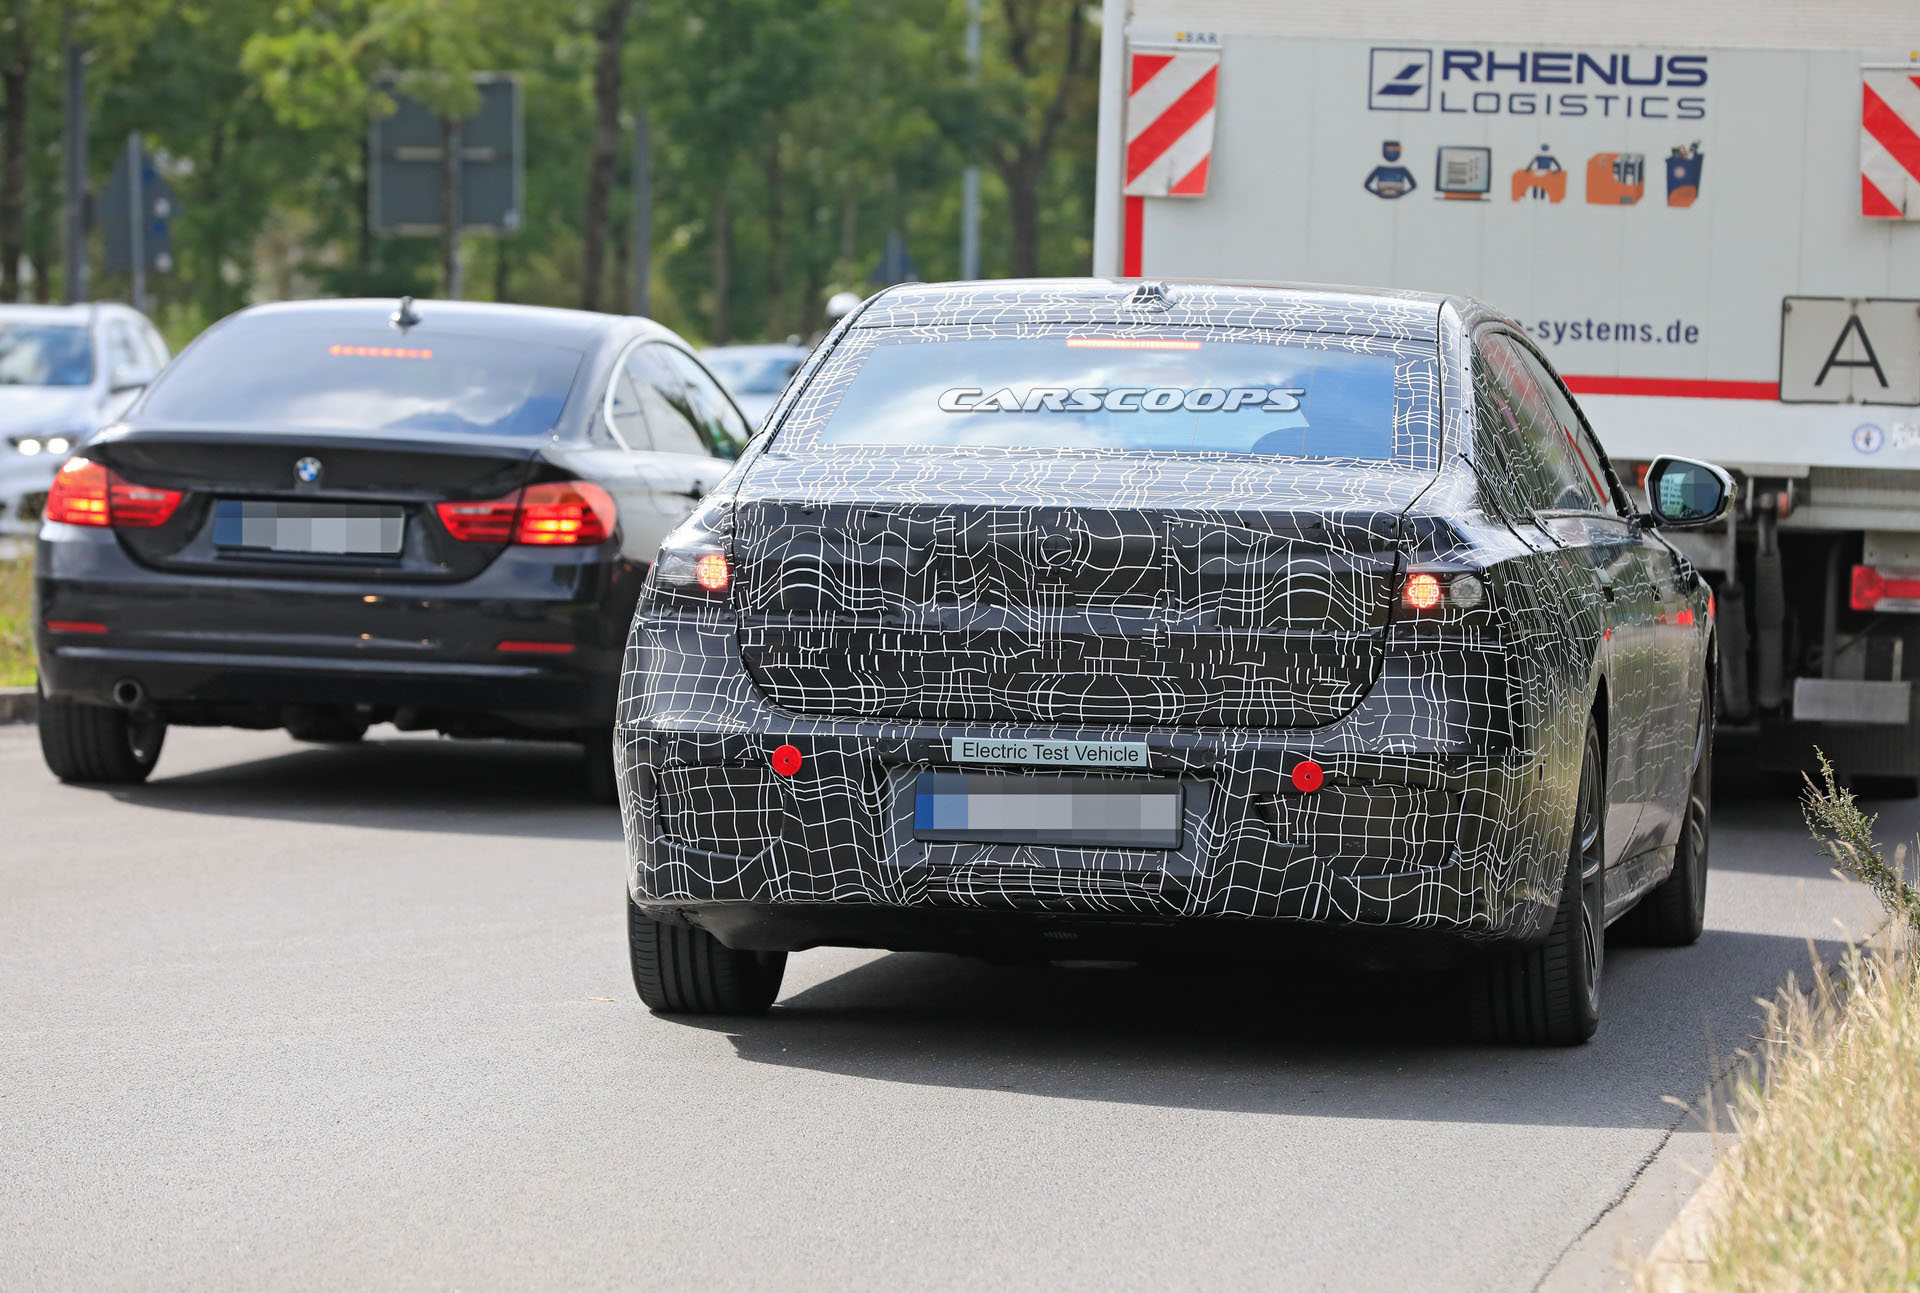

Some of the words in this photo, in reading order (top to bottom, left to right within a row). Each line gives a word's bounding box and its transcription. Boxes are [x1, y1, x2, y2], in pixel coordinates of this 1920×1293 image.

[1442, 50, 1708, 87] RHENUS
[1441, 91, 1706, 120] LOGISTICS
[1813, 314, 1889, 389] A
[962, 741, 1028, 760] Electric
[1032, 744, 1070, 761] Test
[1074, 744, 1140, 762] Vehicle
